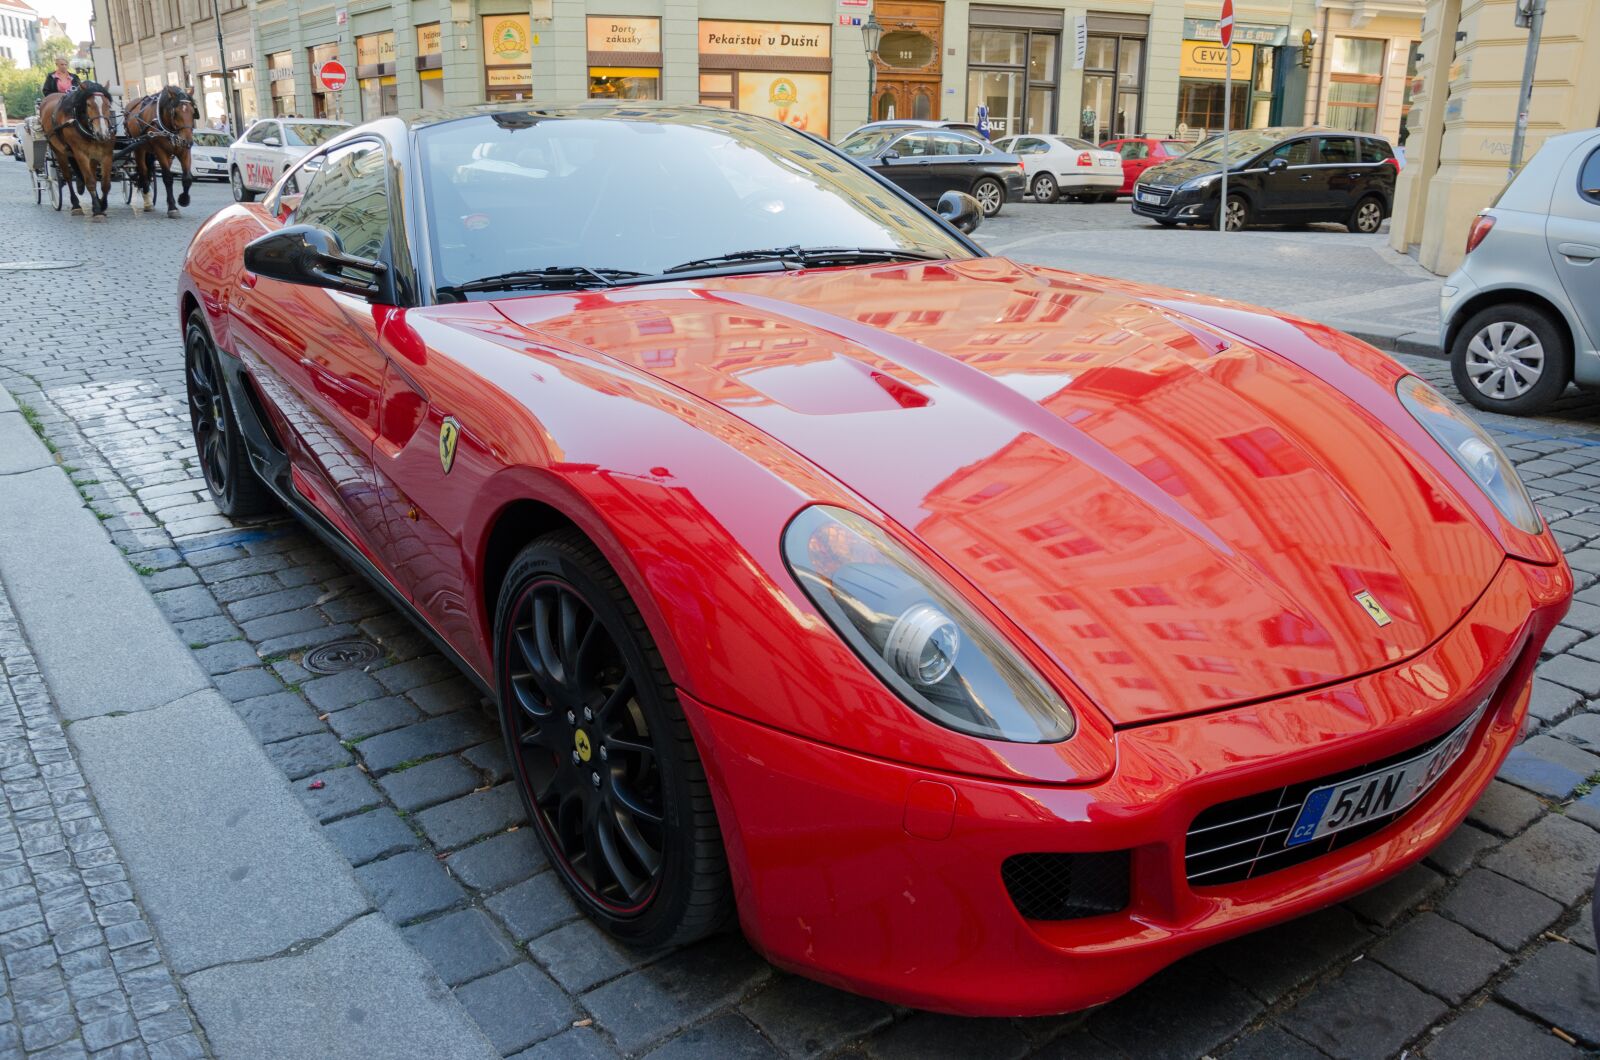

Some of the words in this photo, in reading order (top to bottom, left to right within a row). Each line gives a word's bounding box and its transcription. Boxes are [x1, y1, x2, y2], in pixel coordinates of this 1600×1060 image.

[611, 24, 637, 34] Dorty
[606, 35, 642, 45] zákusky
[708, 33, 761, 45] Pekařství
[768, 37, 776, 46] v
[780, 34, 819, 47] Dušní
[1201, 50, 1235, 61] EVV
[980, 121, 1005, 131] SALE
[1328, 770, 1405, 828] 5AN
[1294, 823, 1313, 839] CZ
